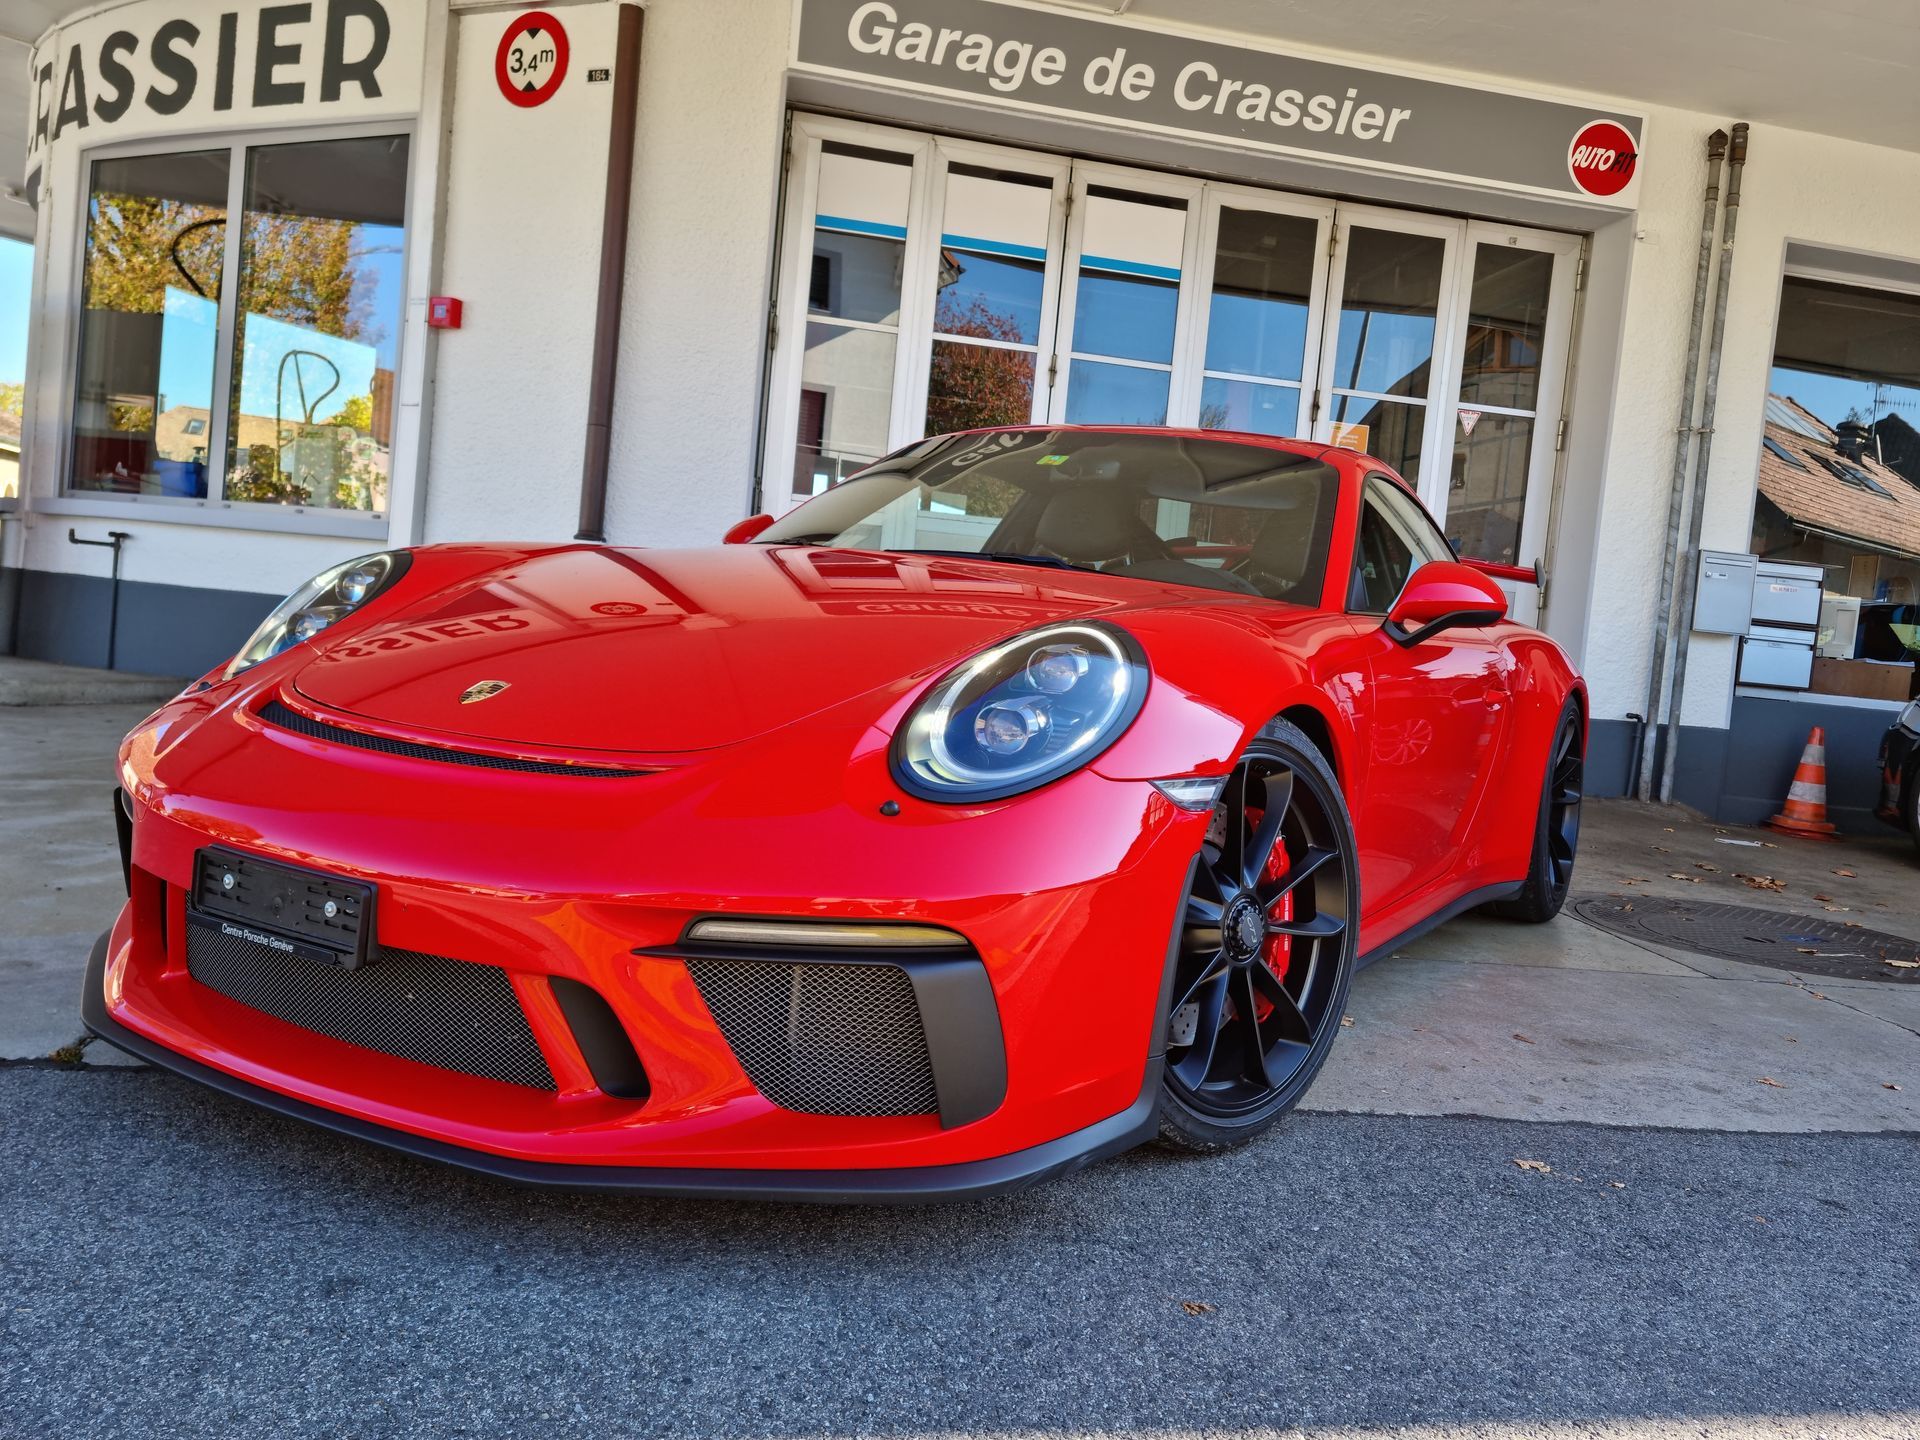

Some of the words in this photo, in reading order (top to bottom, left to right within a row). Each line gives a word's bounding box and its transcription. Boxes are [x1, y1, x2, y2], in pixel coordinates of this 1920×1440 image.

[847, 1, 1067, 92] Garage
[1083, 48, 1155, 101] de
[1173, 61, 1411, 143] Crassier
[222, 923, 242, 938] Centre
[243, 929, 268, 946] Porsche
[269, 937, 294, 953] Genève
